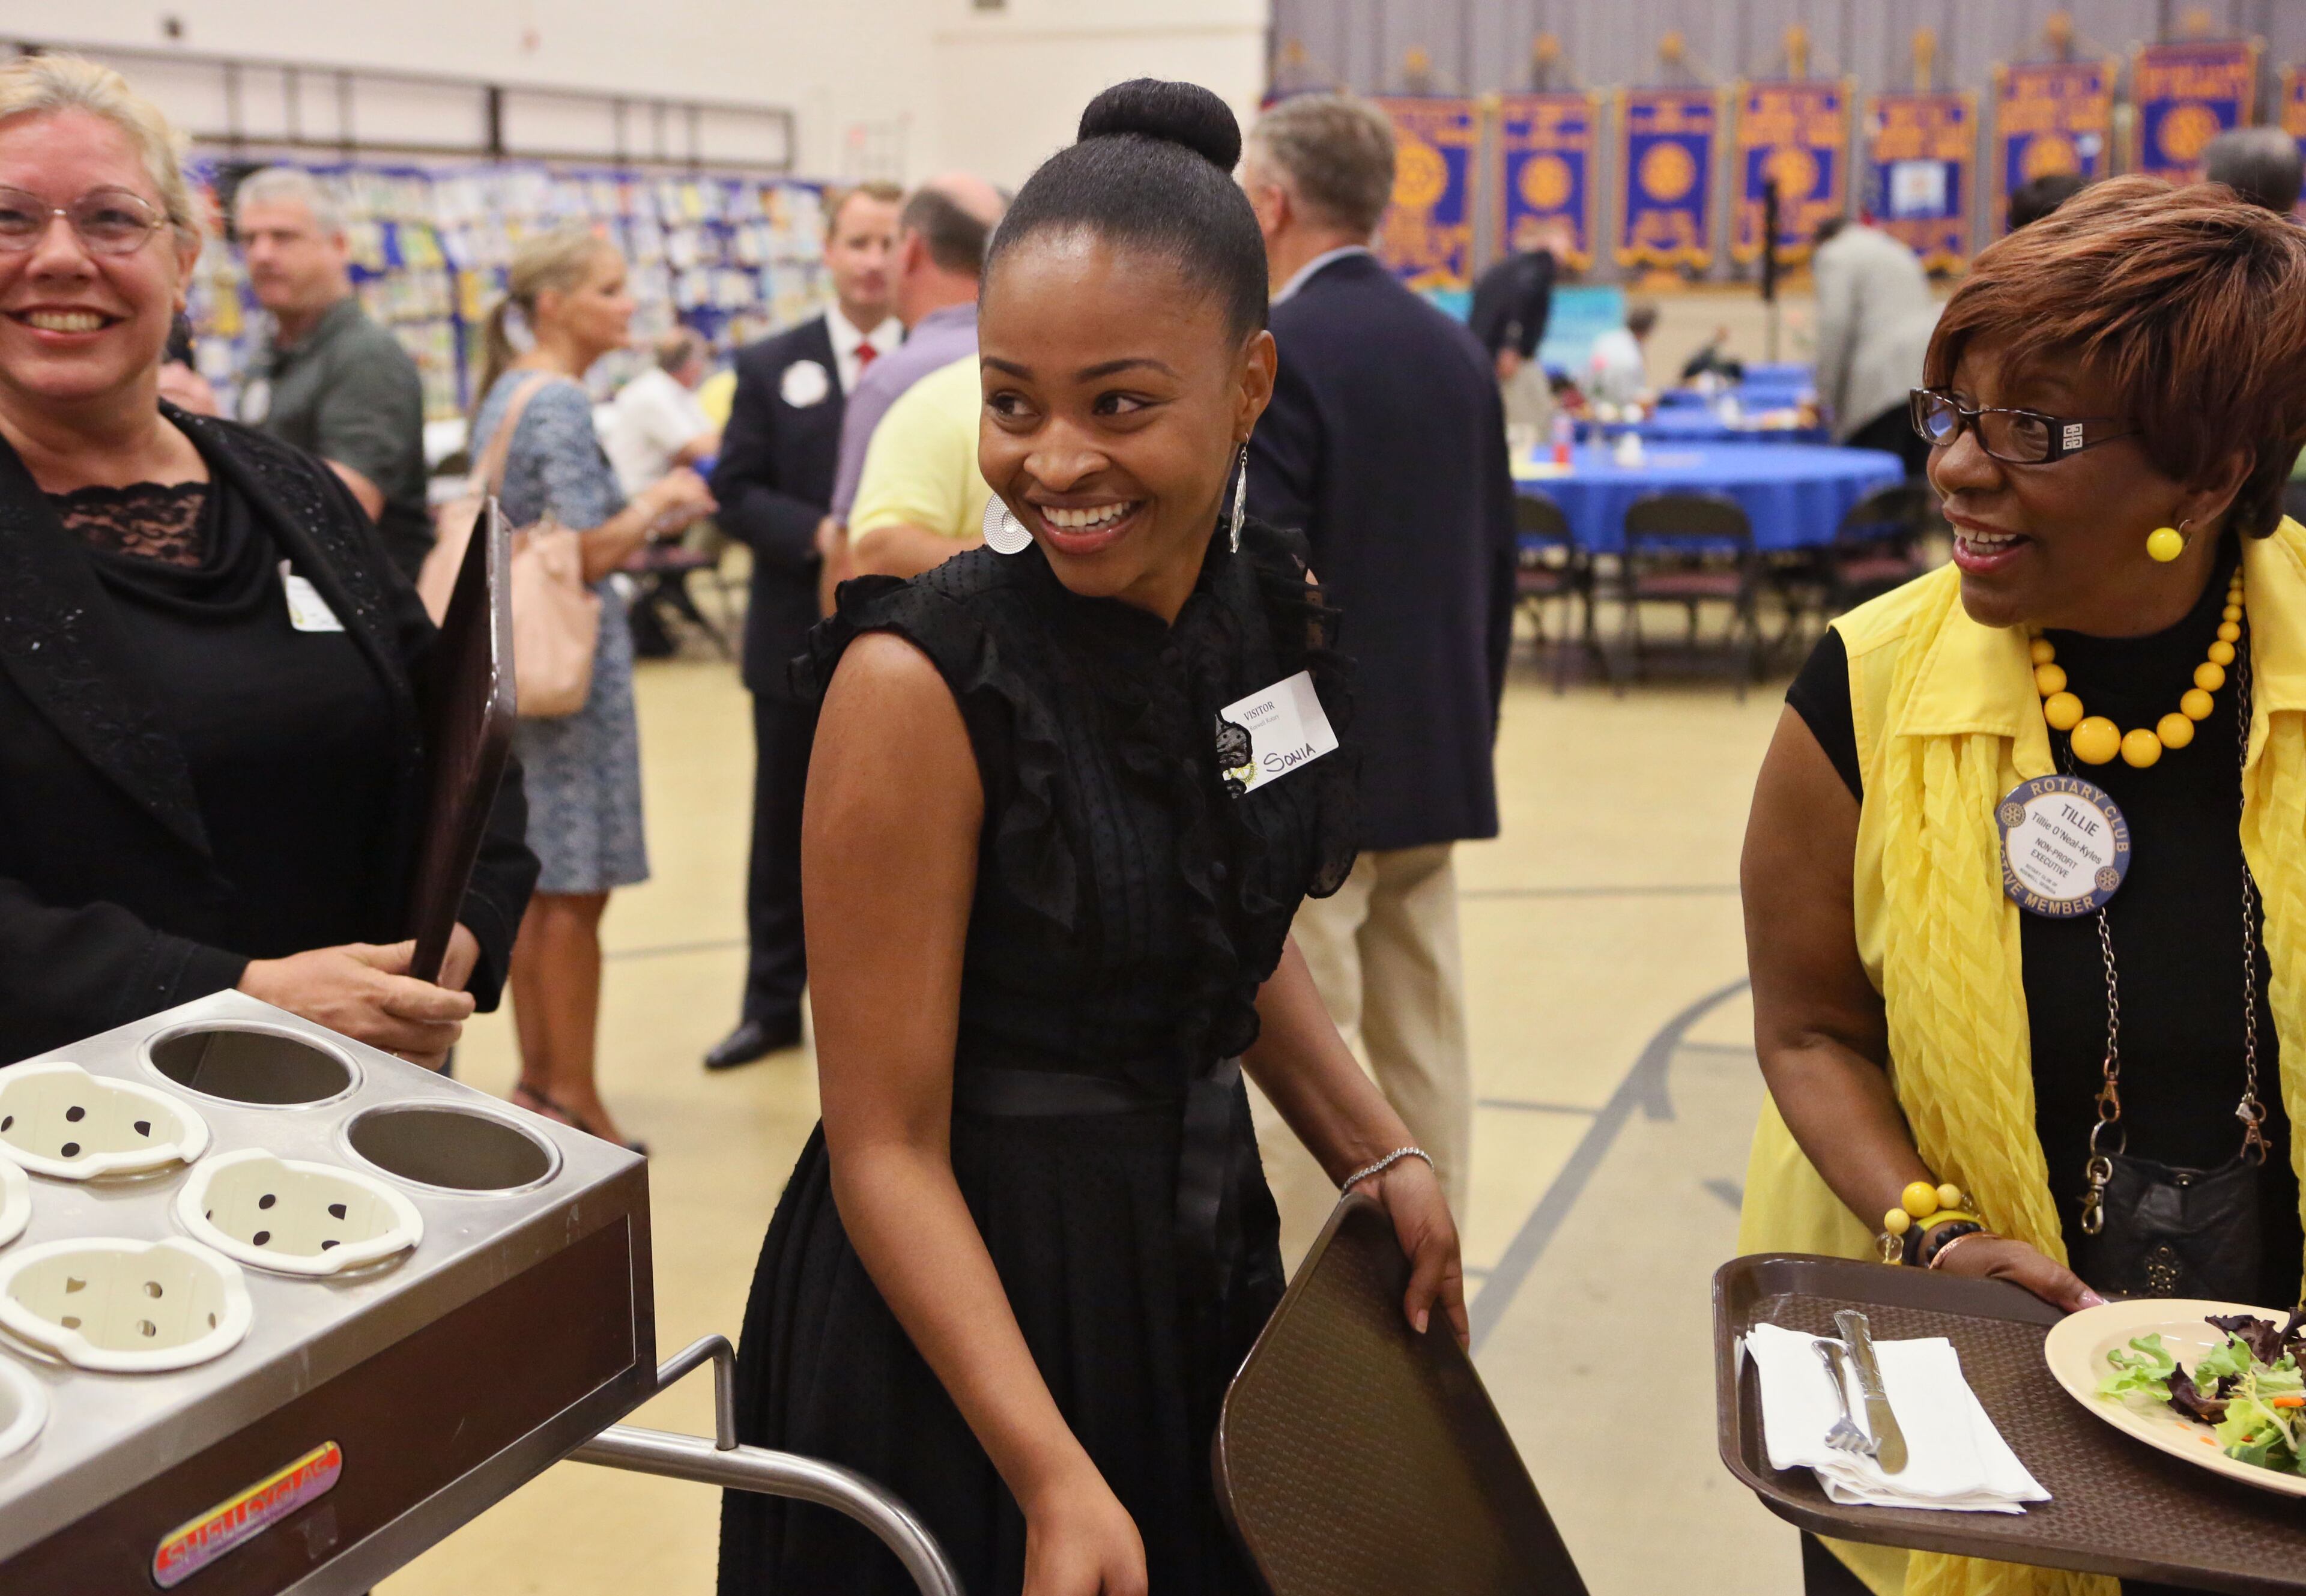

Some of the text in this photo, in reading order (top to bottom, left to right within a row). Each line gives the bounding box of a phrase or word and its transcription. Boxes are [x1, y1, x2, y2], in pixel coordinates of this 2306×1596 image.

[1244, 701, 1275, 721] VISITOR
[1263, 743, 1316, 772] SONIA
[2030, 778, 2129, 853] ROTARY CLUB
[2061, 803, 2099, 837] TILLIE
[2032, 812, 2102, 865] Tillie O'Neal-Kyles
[2035, 838, 2078, 869] NON-PROFIT
[2030, 849, 2069, 878] EXECUTIVE
[2024, 895, 2095, 914] MEMBER
